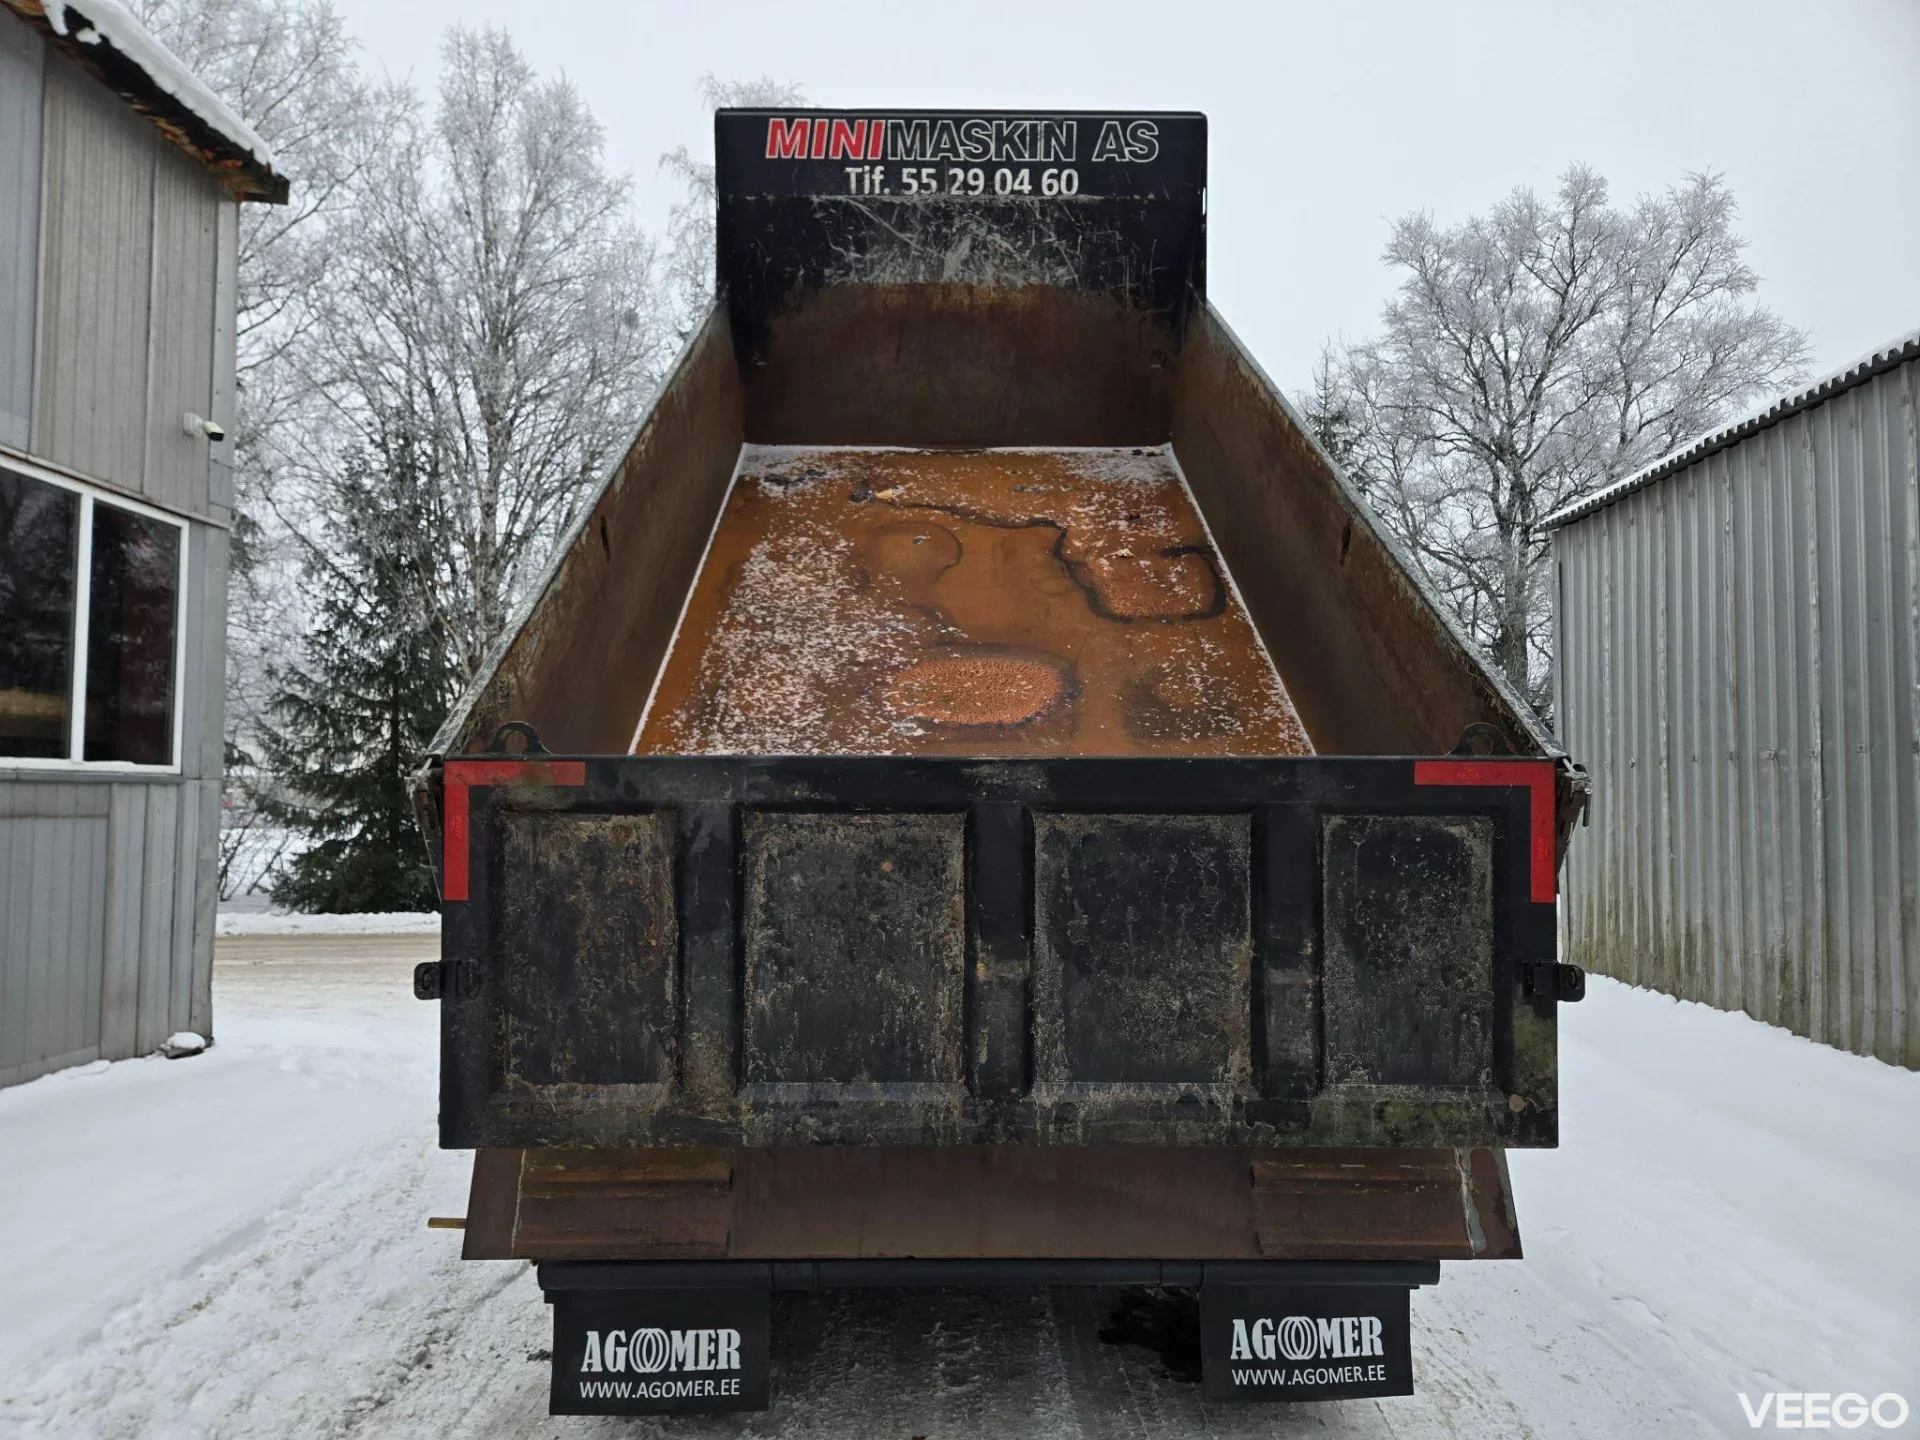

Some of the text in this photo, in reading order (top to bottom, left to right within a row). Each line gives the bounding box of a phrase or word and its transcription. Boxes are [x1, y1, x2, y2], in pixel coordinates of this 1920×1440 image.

[1091, 120, 1159, 163] AS
[901, 167, 937, 195] 55
[949, 167, 985, 196] 29
[994, 168, 1032, 195] 04
[1041, 168, 1079, 196] 60
[580, 1328, 741, 1373] AGOMER
[1230, 1316, 1384, 1360] AGOMER
[579, 1378, 741, 1398] WWW.AGOMER.EE
[1231, 1364, 1387, 1386] WWW.AGOMER.EE
